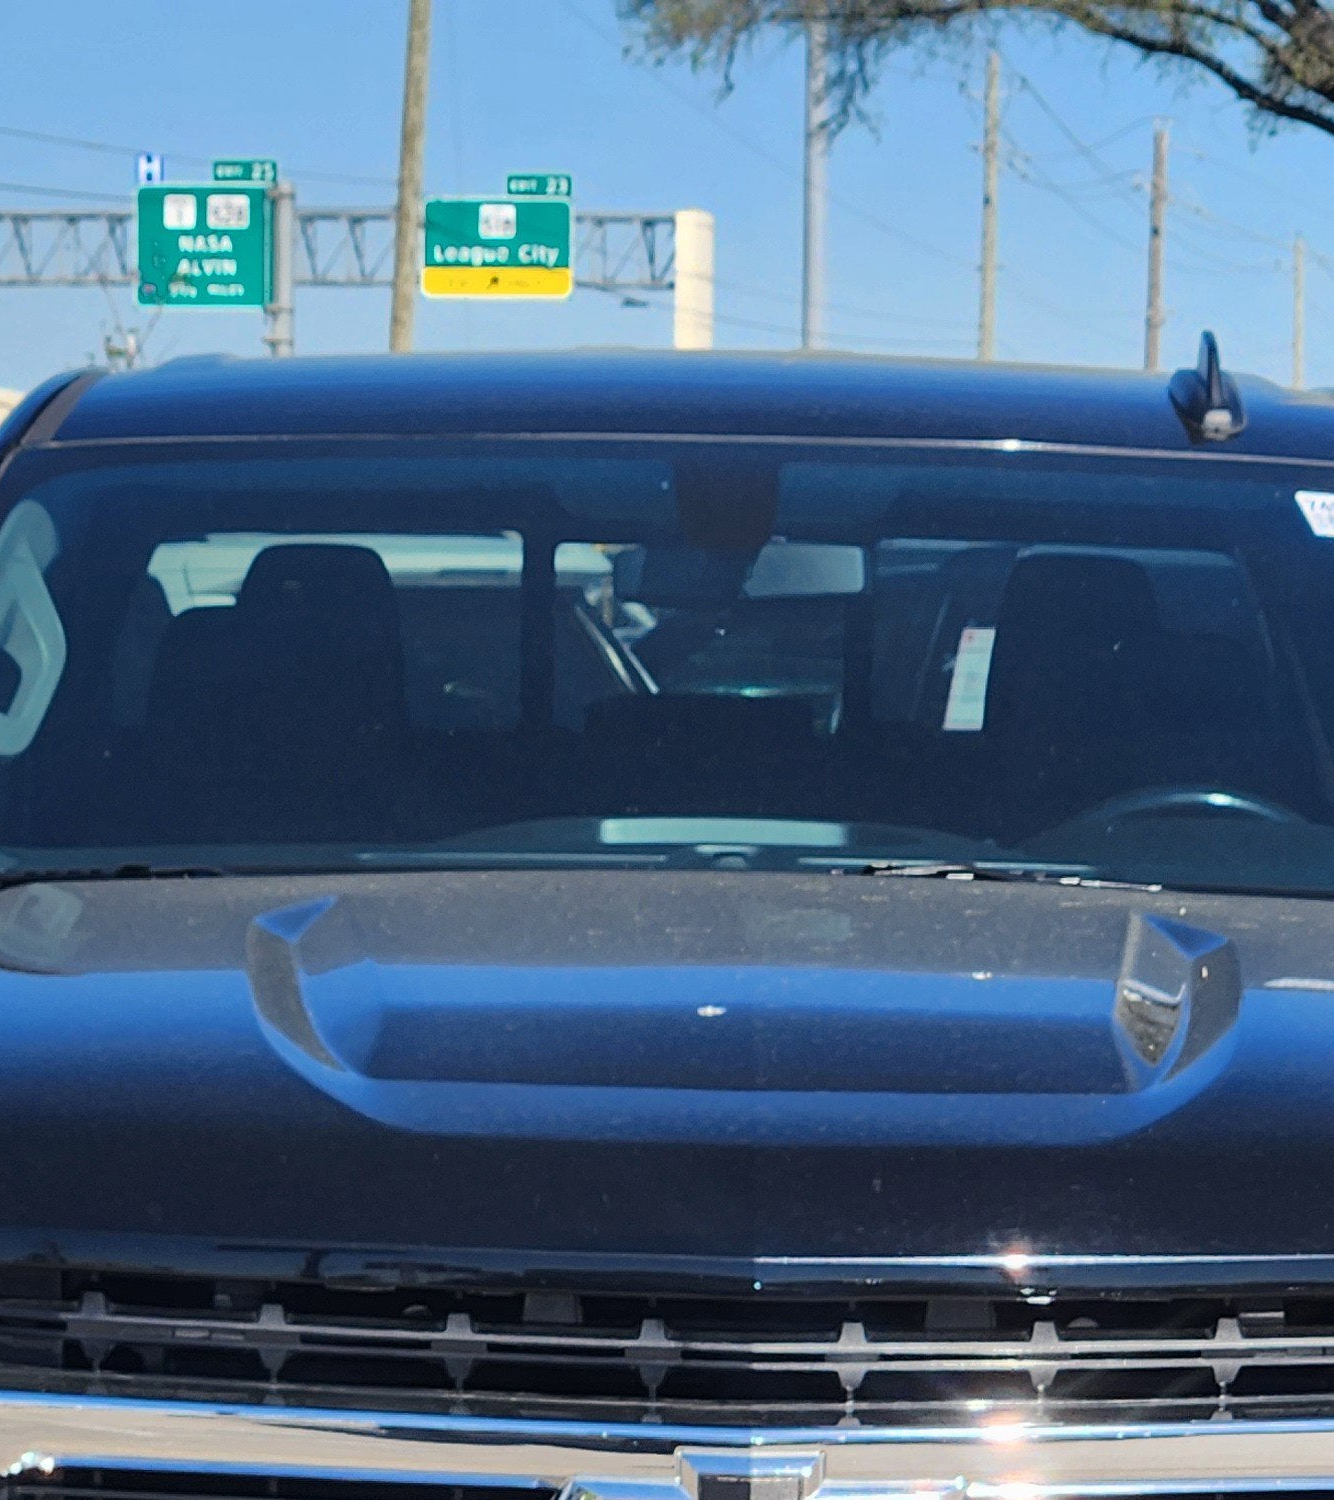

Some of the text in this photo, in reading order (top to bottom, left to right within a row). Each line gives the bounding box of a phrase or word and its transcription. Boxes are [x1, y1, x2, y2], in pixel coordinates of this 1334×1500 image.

[178, 234, 233, 253] NASA
[433, 244, 560, 268] League City
[176, 258, 238, 277] ALVIN
